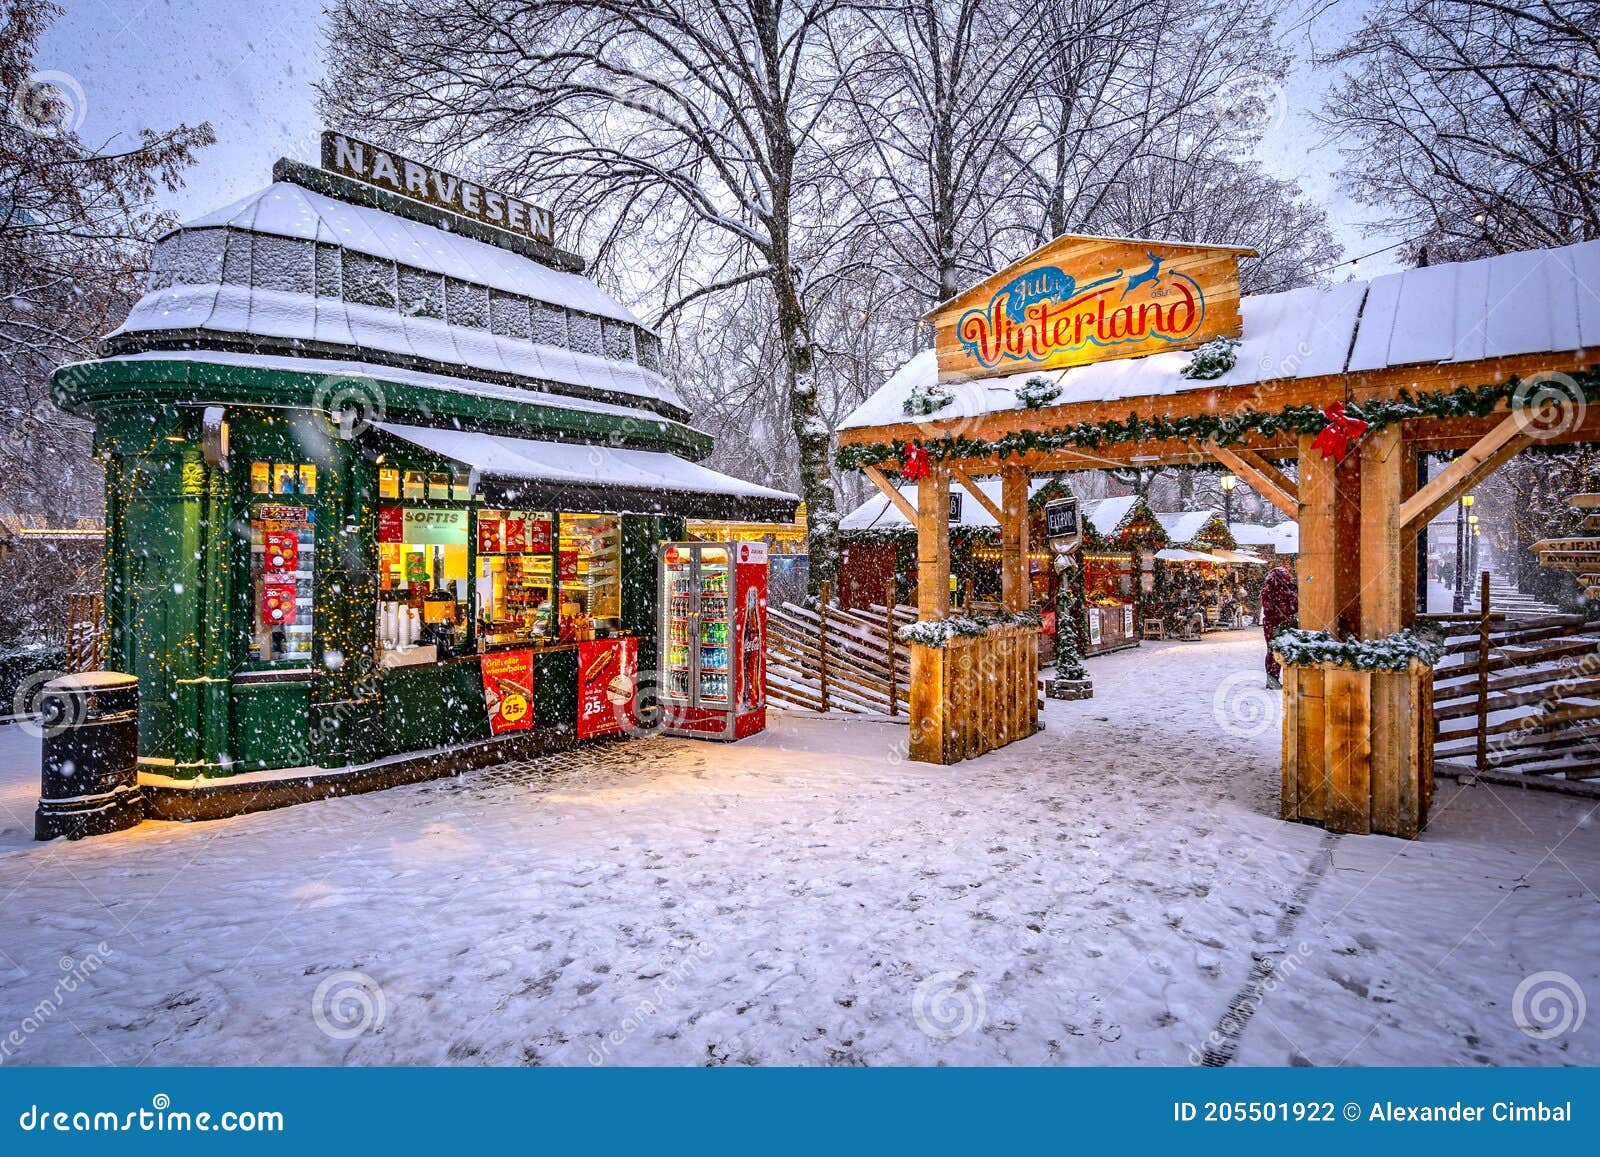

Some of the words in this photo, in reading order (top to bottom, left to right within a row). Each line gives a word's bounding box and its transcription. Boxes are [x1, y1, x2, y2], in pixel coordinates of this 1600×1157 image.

[334, 136, 551, 237] NARVESEN
[964, 282, 1196, 363] Vinterland
[404, 511, 459, 523] SOFTIS
